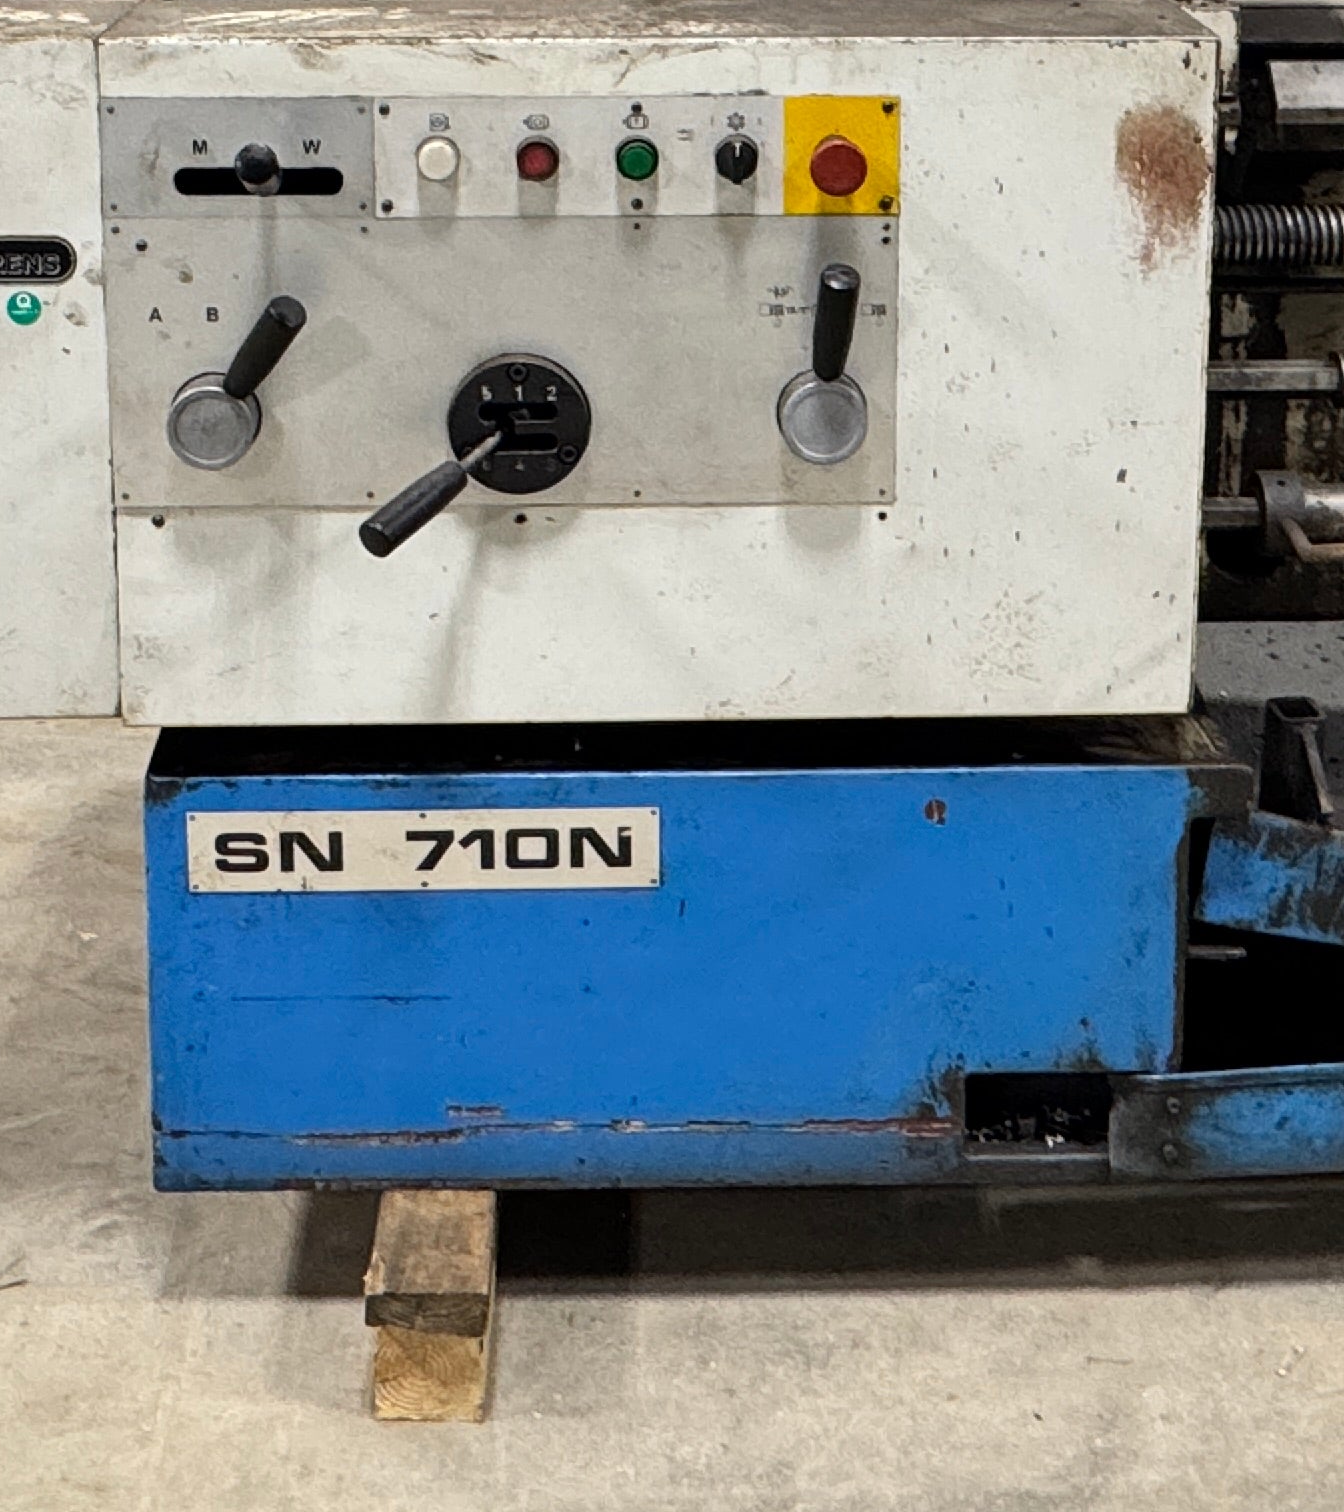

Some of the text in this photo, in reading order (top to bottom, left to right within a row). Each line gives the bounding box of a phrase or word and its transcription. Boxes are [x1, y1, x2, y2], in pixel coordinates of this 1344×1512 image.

[193, 139, 208, 155] M
[302, 139, 321, 154] W
[148, 307, 163, 322] A
[207, 307, 219, 322] B
[481, 385, 558, 401] 5 1 2
[214, 826, 632, 872] SN 710N
